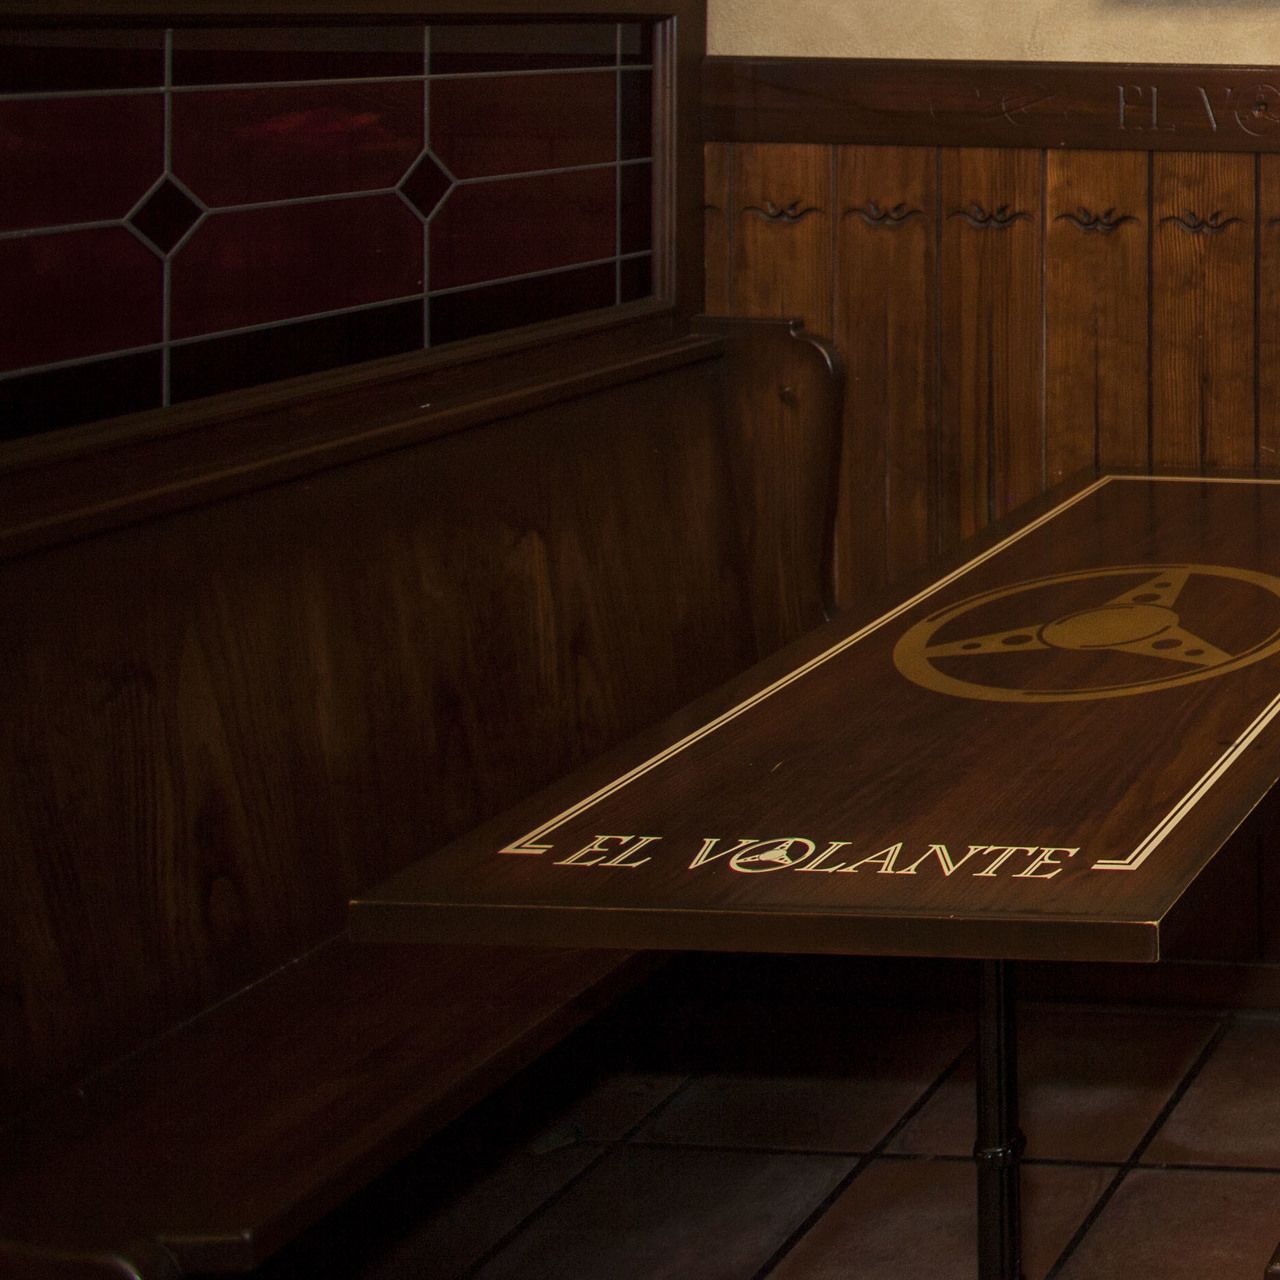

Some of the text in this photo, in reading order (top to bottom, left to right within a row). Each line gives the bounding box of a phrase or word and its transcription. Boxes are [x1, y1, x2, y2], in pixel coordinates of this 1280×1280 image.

[1116, 84, 1177, 134] EL
[553, 834, 1081, 879] EL VOLANTE
